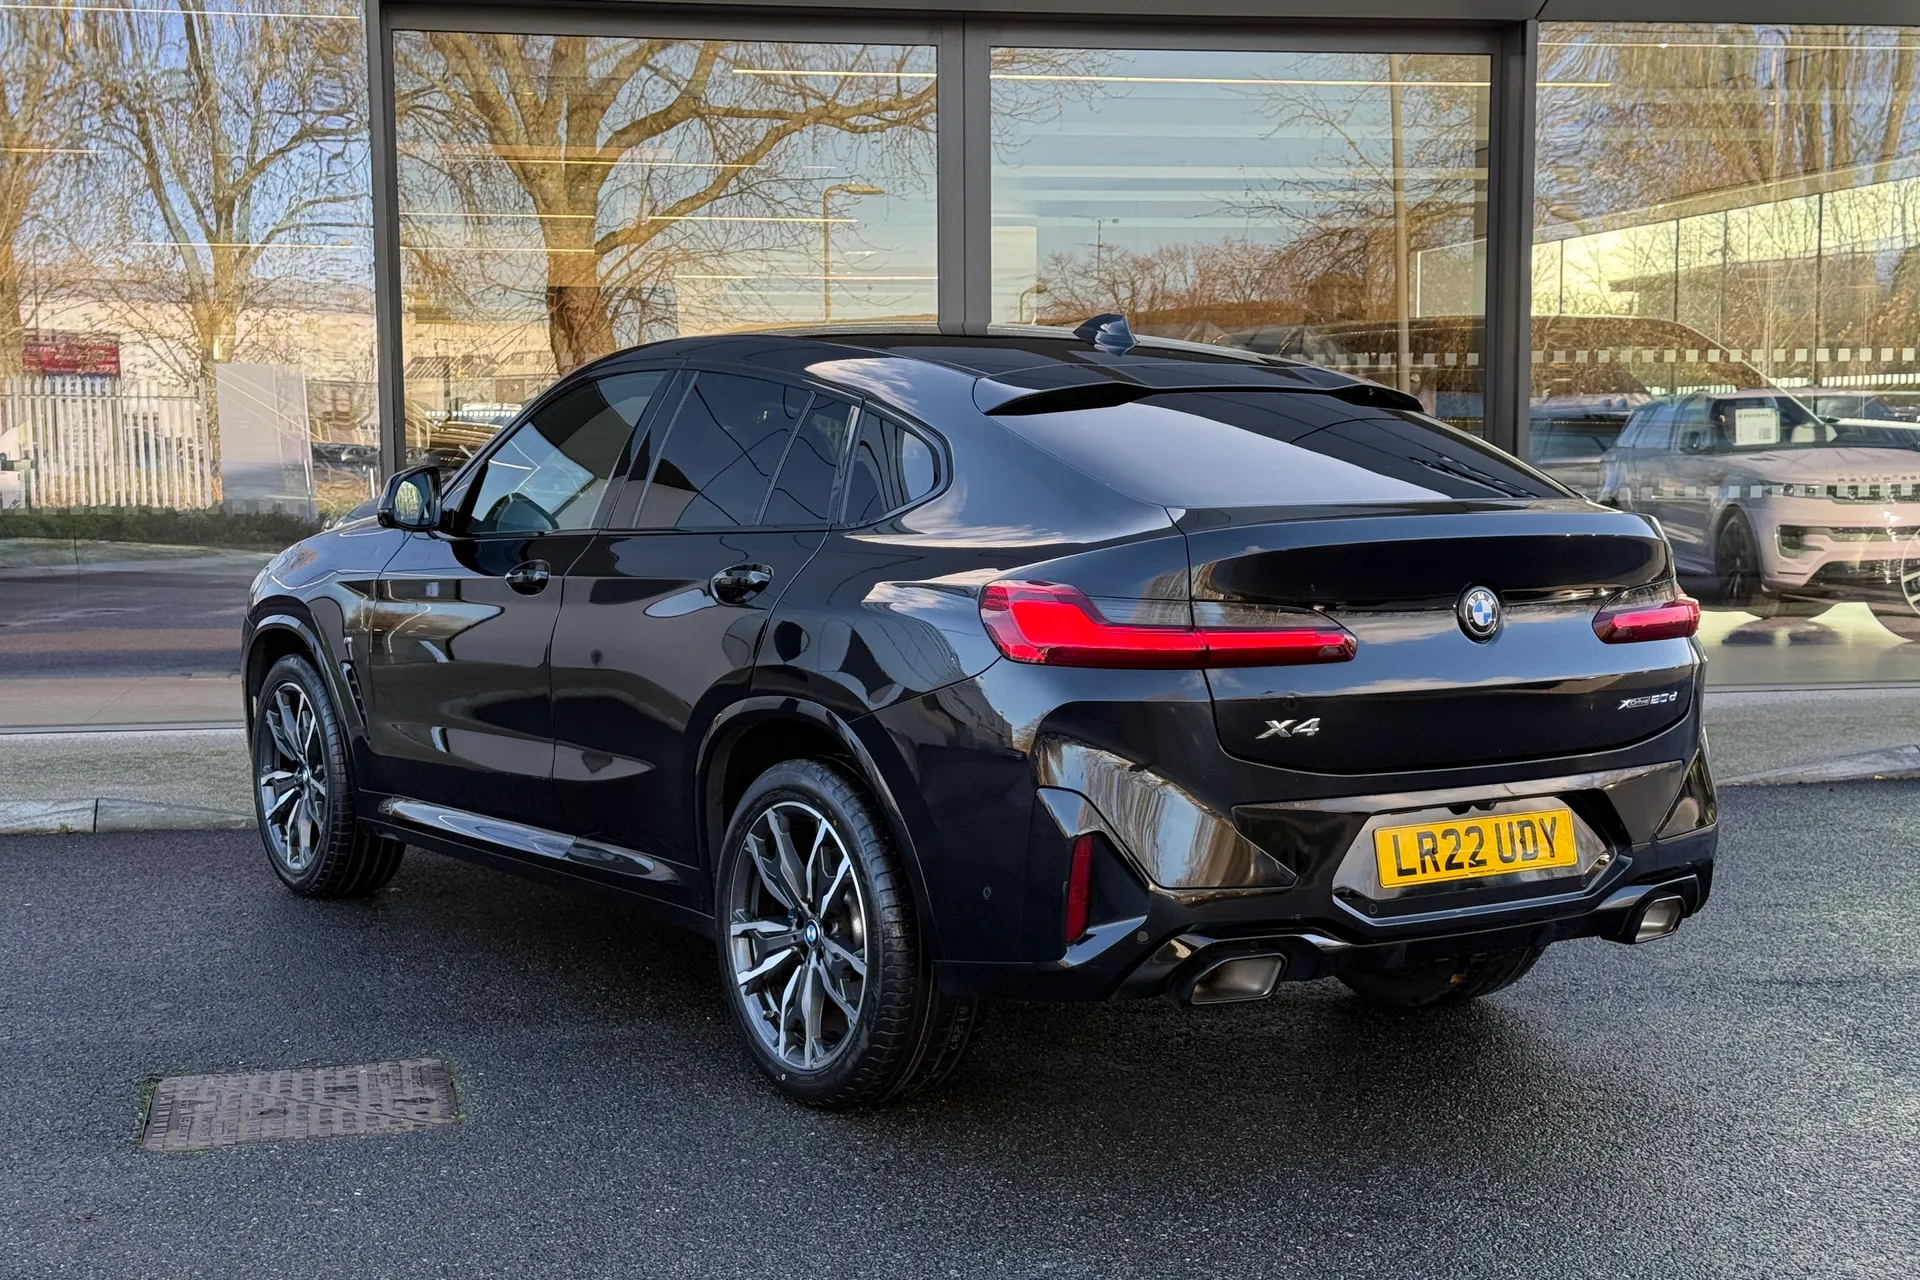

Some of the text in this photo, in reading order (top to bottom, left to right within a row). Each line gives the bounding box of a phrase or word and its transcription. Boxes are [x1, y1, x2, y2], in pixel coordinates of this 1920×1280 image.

[1254, 717, 1321, 739] X4
[1392, 816, 1557, 877] LR22 UDY
